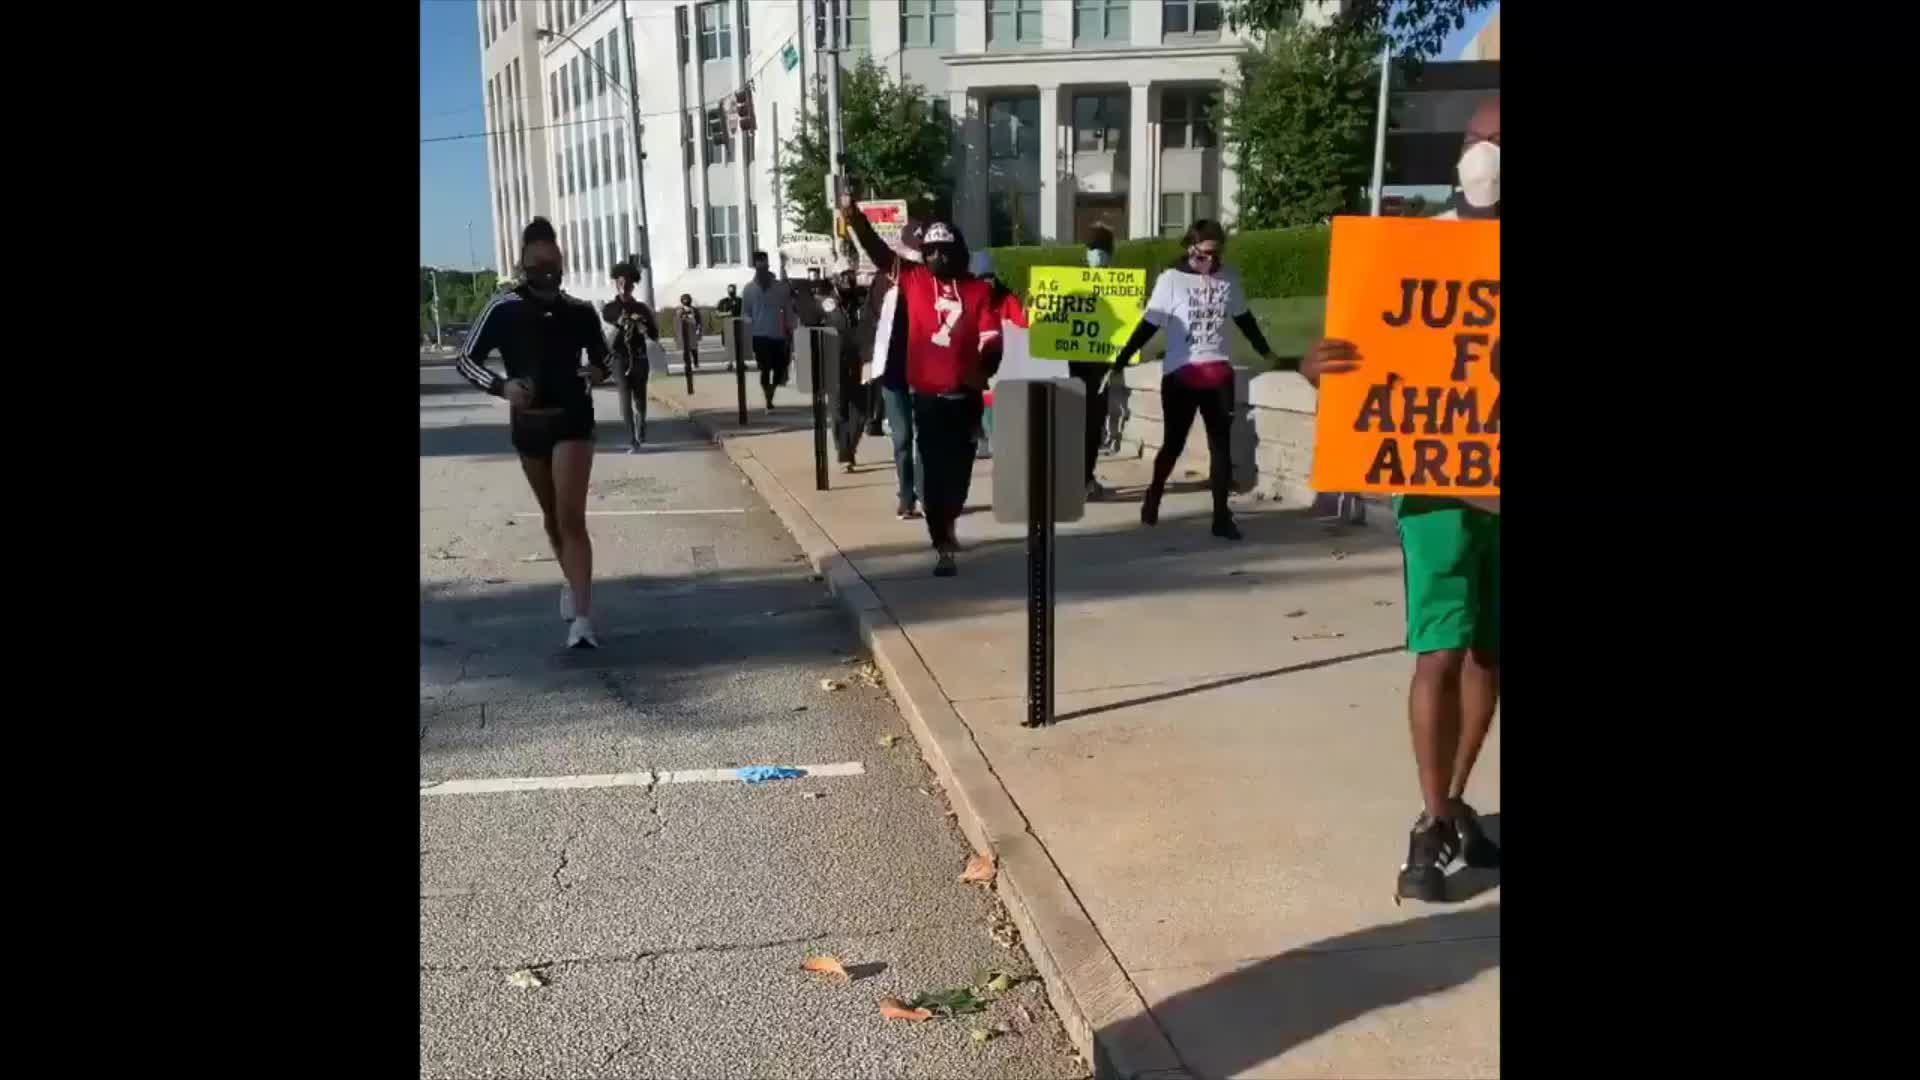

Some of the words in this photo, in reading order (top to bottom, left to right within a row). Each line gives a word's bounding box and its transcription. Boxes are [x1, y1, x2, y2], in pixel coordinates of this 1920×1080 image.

[1107, 271, 1135, 283] TOM
[1035, 294, 1097, 313] CHRIS
[931, 296, 962, 347] 7
[1071, 320, 1100, 337] DO
[1451, 333, 1500, 382] F
[1365, 438, 1500, 487] ARB
